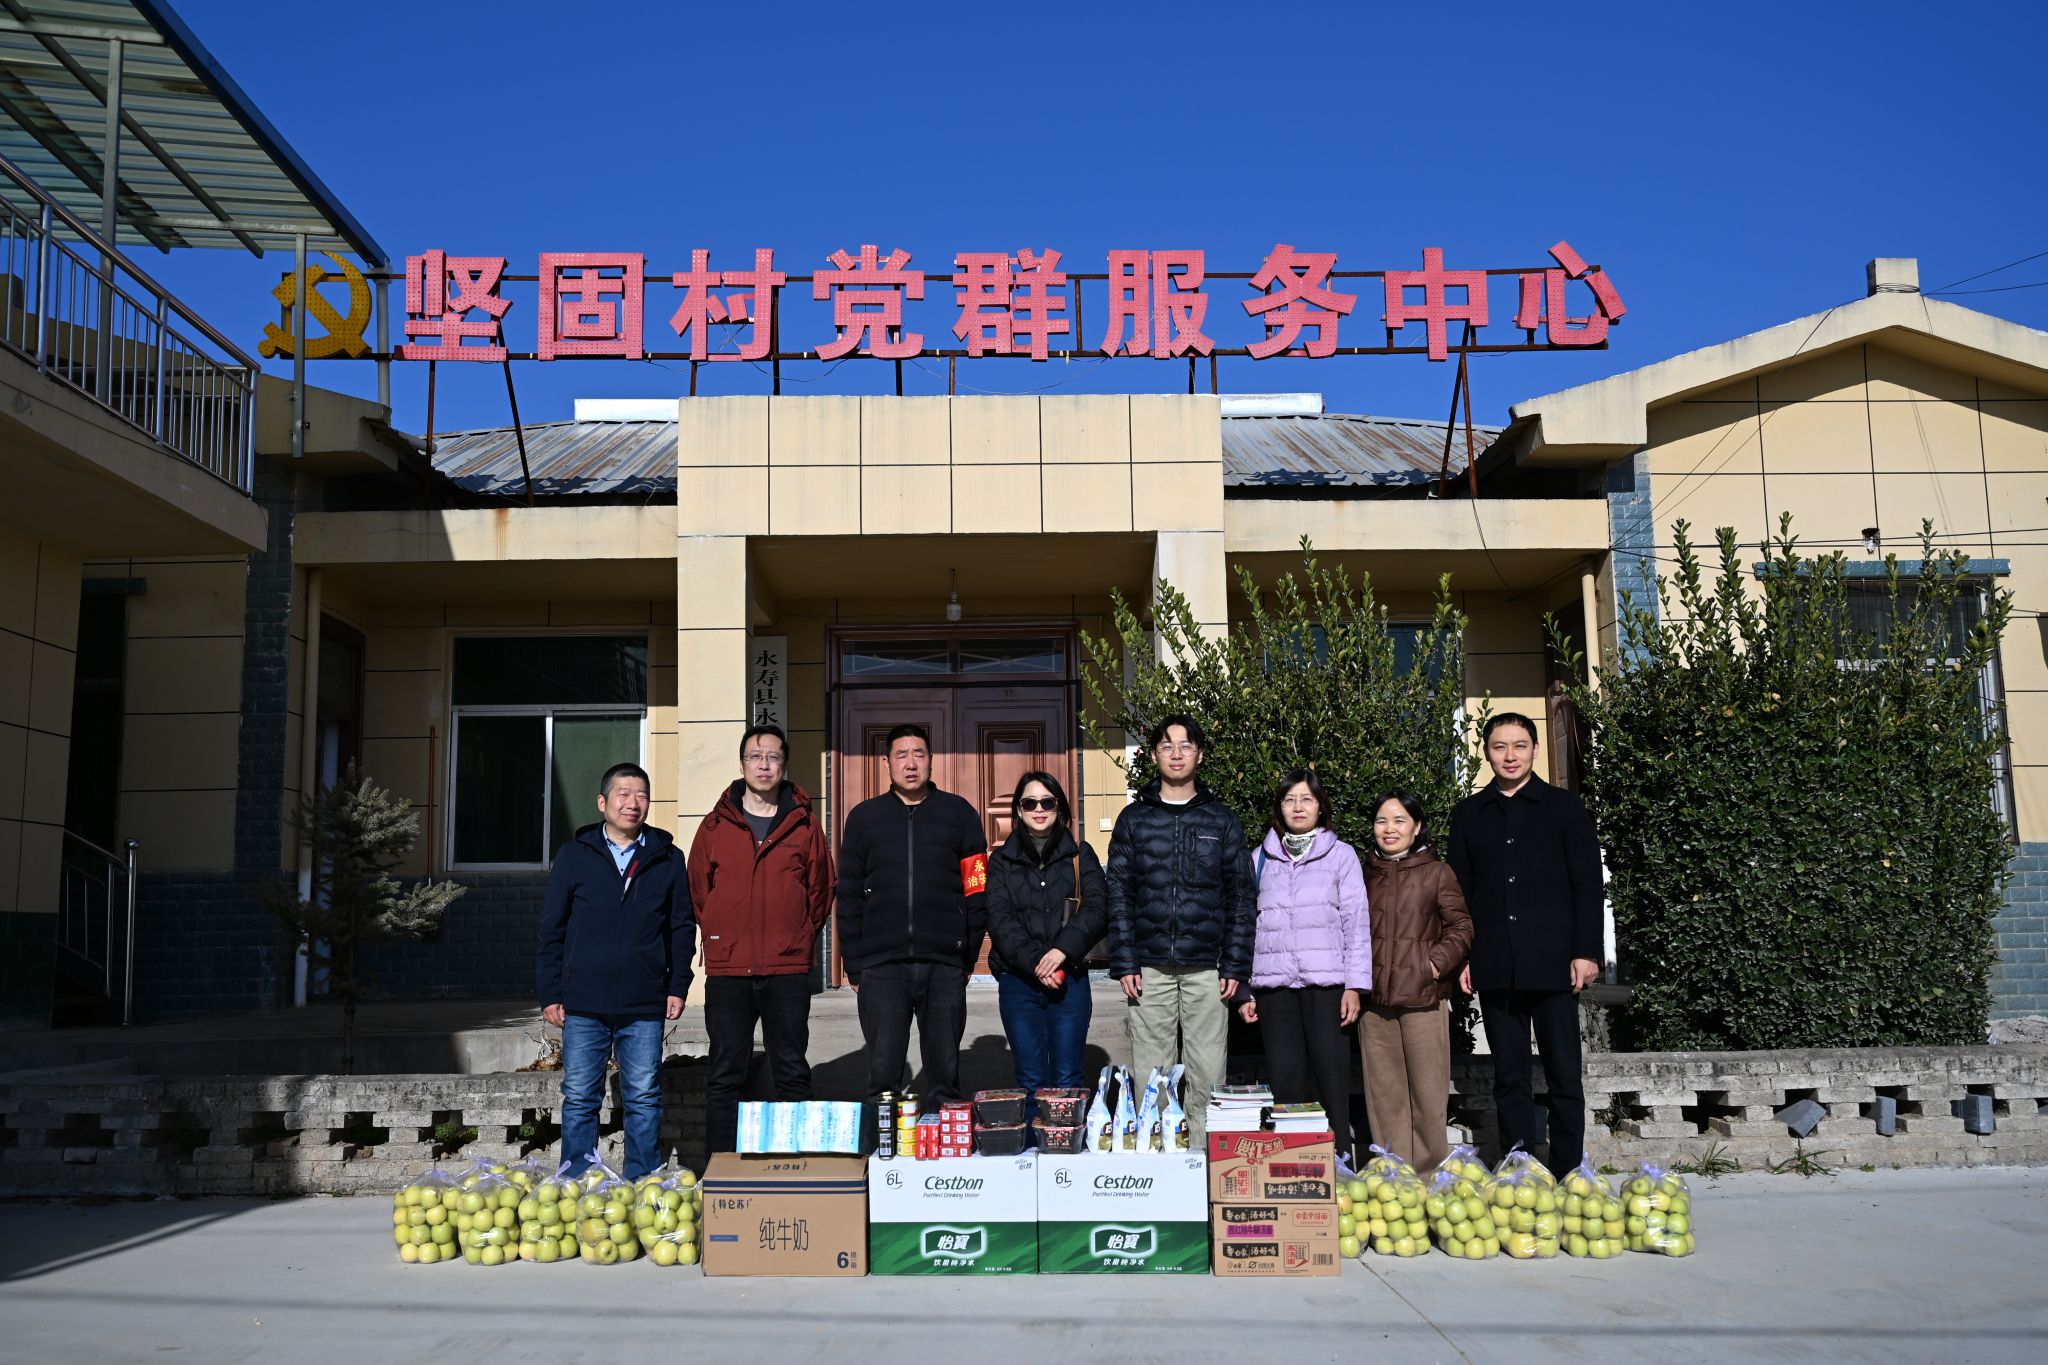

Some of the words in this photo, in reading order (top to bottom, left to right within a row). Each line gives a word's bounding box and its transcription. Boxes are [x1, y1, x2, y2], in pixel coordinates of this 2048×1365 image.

[394, 240, 1627, 362] 坚固村党群服务中心
[886, 1172, 903, 1185] 6L
[1055, 1171, 1072, 1184] 6L
[759, 1217, 809, 1251] 纯牛奶
[837, 1252, 849, 1269] 6
